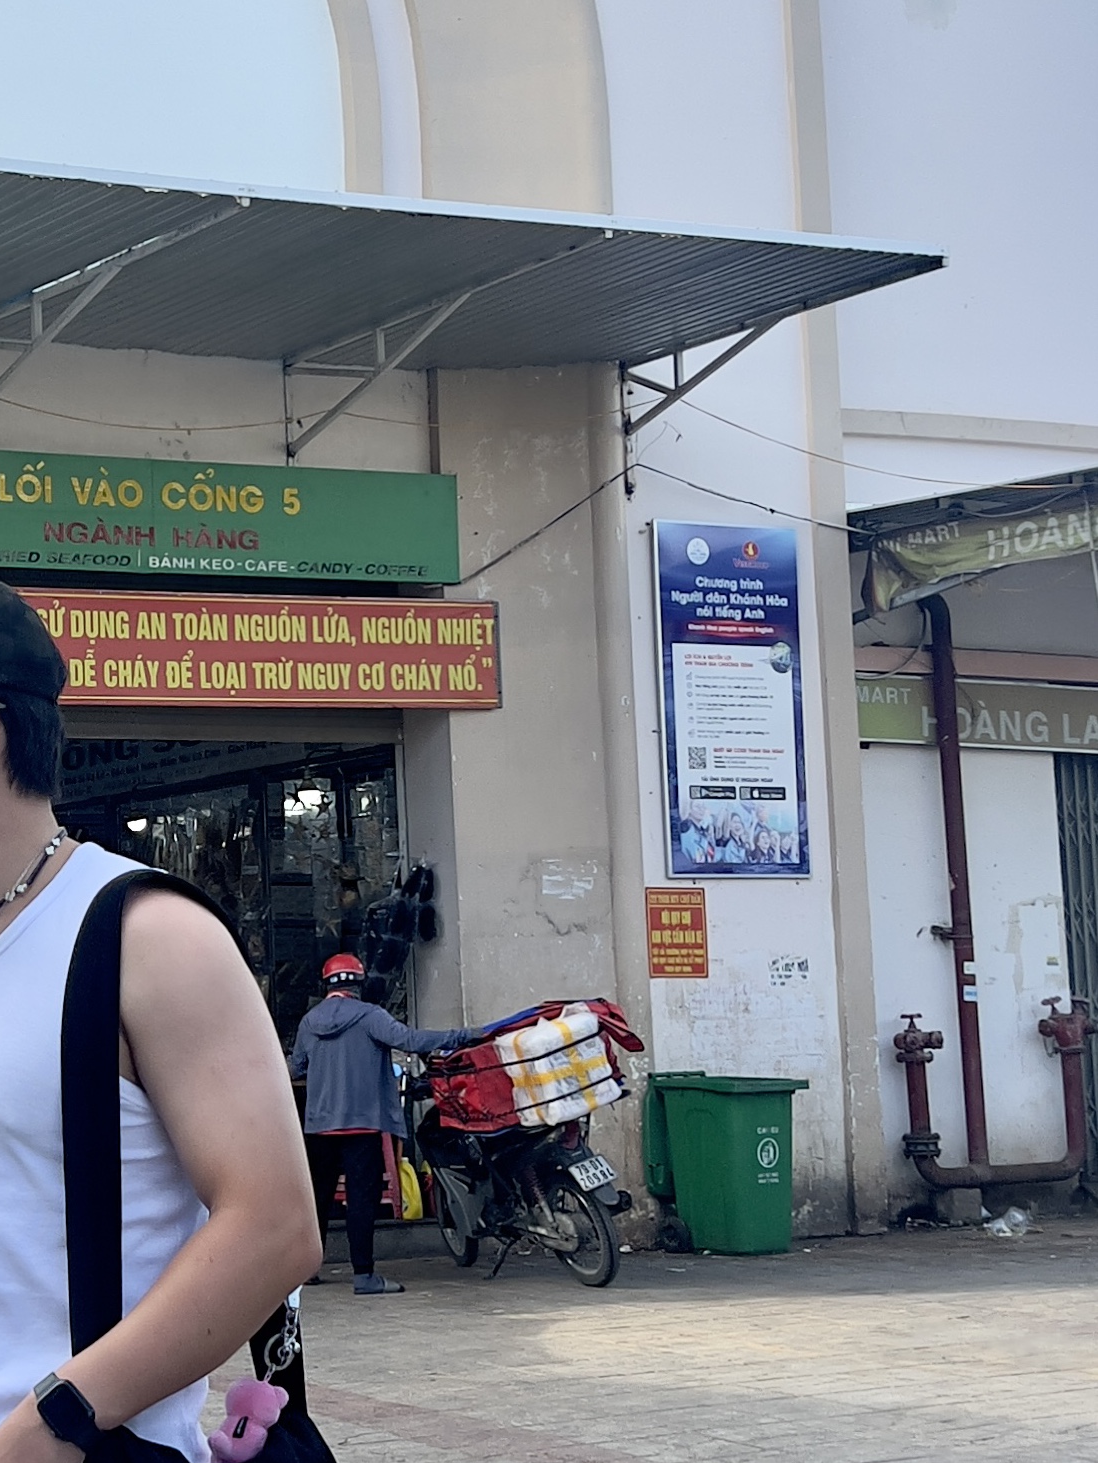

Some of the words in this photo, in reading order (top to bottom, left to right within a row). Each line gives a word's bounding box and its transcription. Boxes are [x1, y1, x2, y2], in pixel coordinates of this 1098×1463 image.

[70, 466, 144, 508] VÀO
[161, 468, 265, 513] CỔNG
[283, 488, 301, 515] 5
[43, 516, 156, 548] NGÀNH
[172, 522, 260, 550] HÀNG
[907, 521, 960, 549] MART
[987, 508, 1098, 561] HOÀN
[46, 551, 132, 567] SEAFOOD
[148, 552, 196, 570] BÁNH
[671, 590, 704, 606] Người
[705, 592, 728, 605] dân
[729, 592, 764, 607] Khánh
[765, 595, 789, 607] Hòa
[695, 576, 738, 592] Chương
[739, 578, 764, 590] trình
[70, 609, 131, 645] DỤNG
[136, 612, 167, 640] AN
[172, 607, 228, 641] TOÀN
[234, 606, 307, 643] NGUỒN
[311, 606, 357, 647] LỬA,
[362, 608, 432, 645] NGUỒN
[437, 612, 494, 651] NHIỆT
[696, 606, 713, 618] nói
[714, 605, 742, 621] tiếng
[743, 609, 765, 620] Anh
[69, 648, 98, 688] DỄ
[103, 654, 160, 688] CHÁY
[166, 649, 194, 689] ĐỂ
[200, 661, 247, 696] LOẠI
[252, 656, 294, 690] TRỪ
[297, 662, 352, 691] NGUY
[358, 660, 385, 691] CƠ
[390, 658, 443, 692] CHÁY
[856, 685, 911, 705] MART
[921, 700, 1050, 744] HOÀNG
